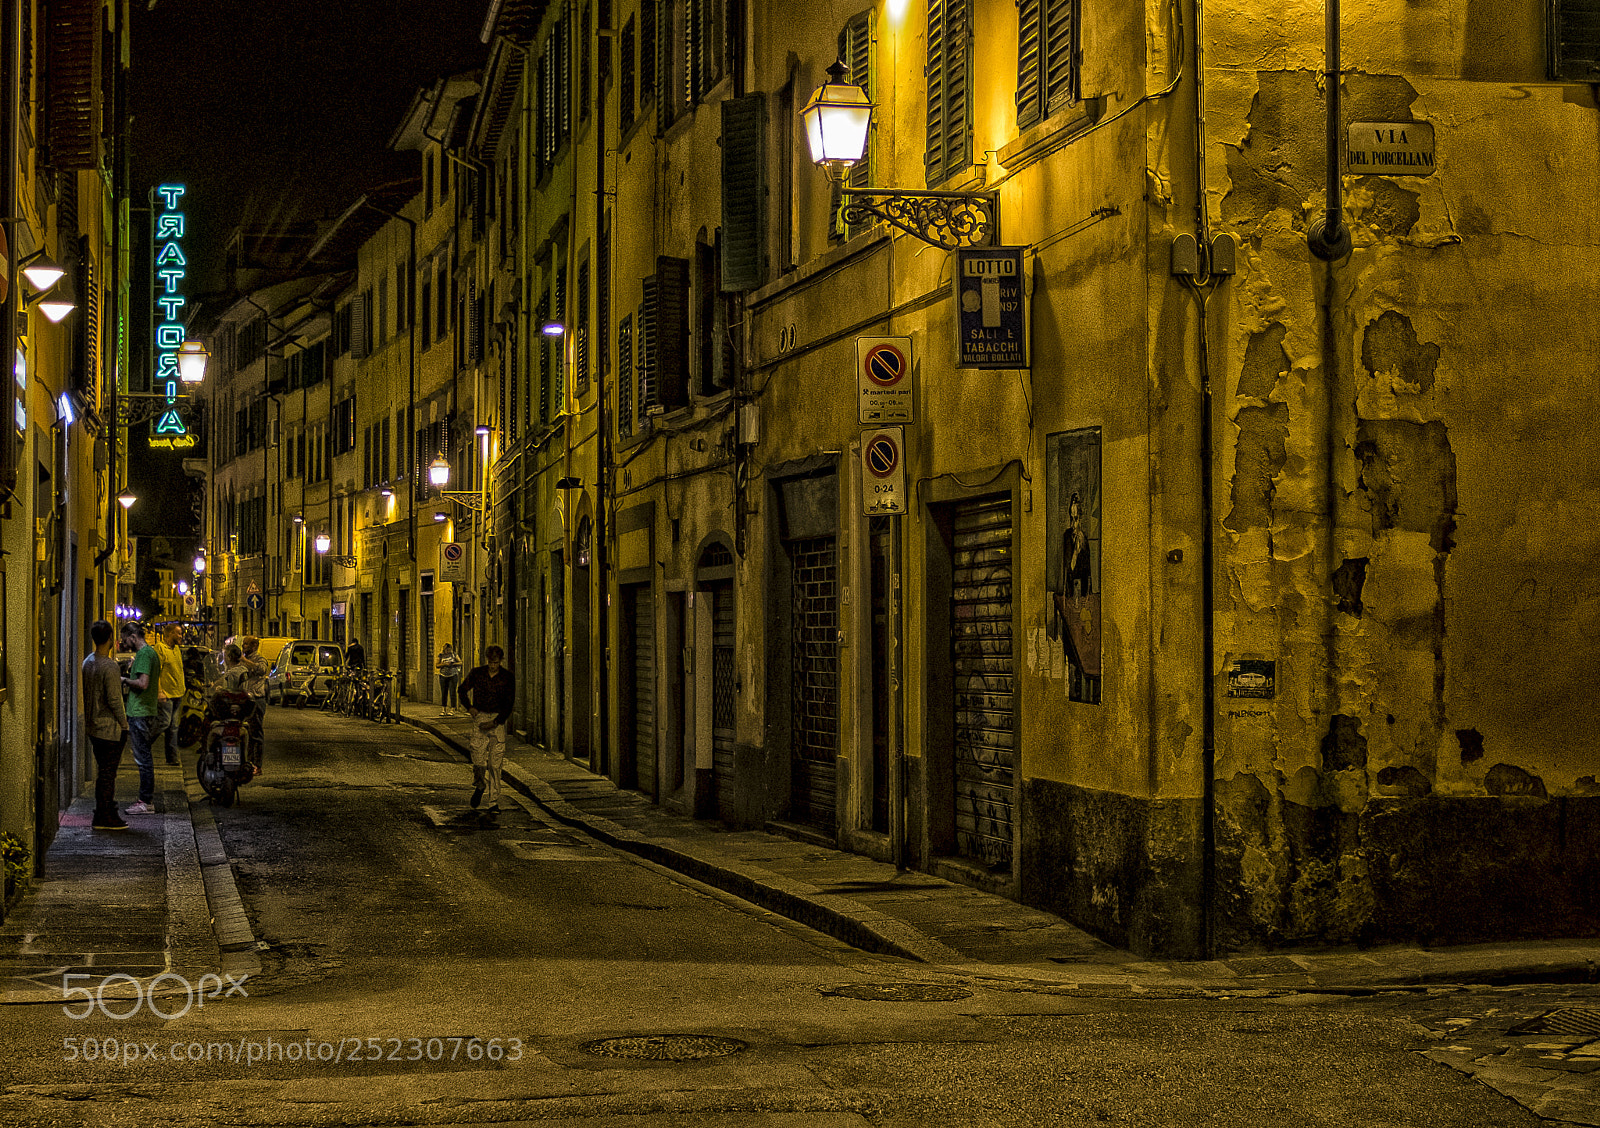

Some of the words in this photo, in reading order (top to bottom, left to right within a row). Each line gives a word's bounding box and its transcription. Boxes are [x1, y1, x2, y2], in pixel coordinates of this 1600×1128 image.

[1374, 129, 1408, 144] VIA
[1349, 150, 1369, 165] DEL
[1372, 151, 1434, 166] PORCELLANA
[969, 260, 1013, 274] LOTTO
[1000, 288, 1017, 298] RIV
[971, 328, 997, 339] SALI
[965, 342, 1018, 353] TABACCHI
[963, 354, 989, 363] VALORI
[991, 353, 1021, 362] BOLLATI
